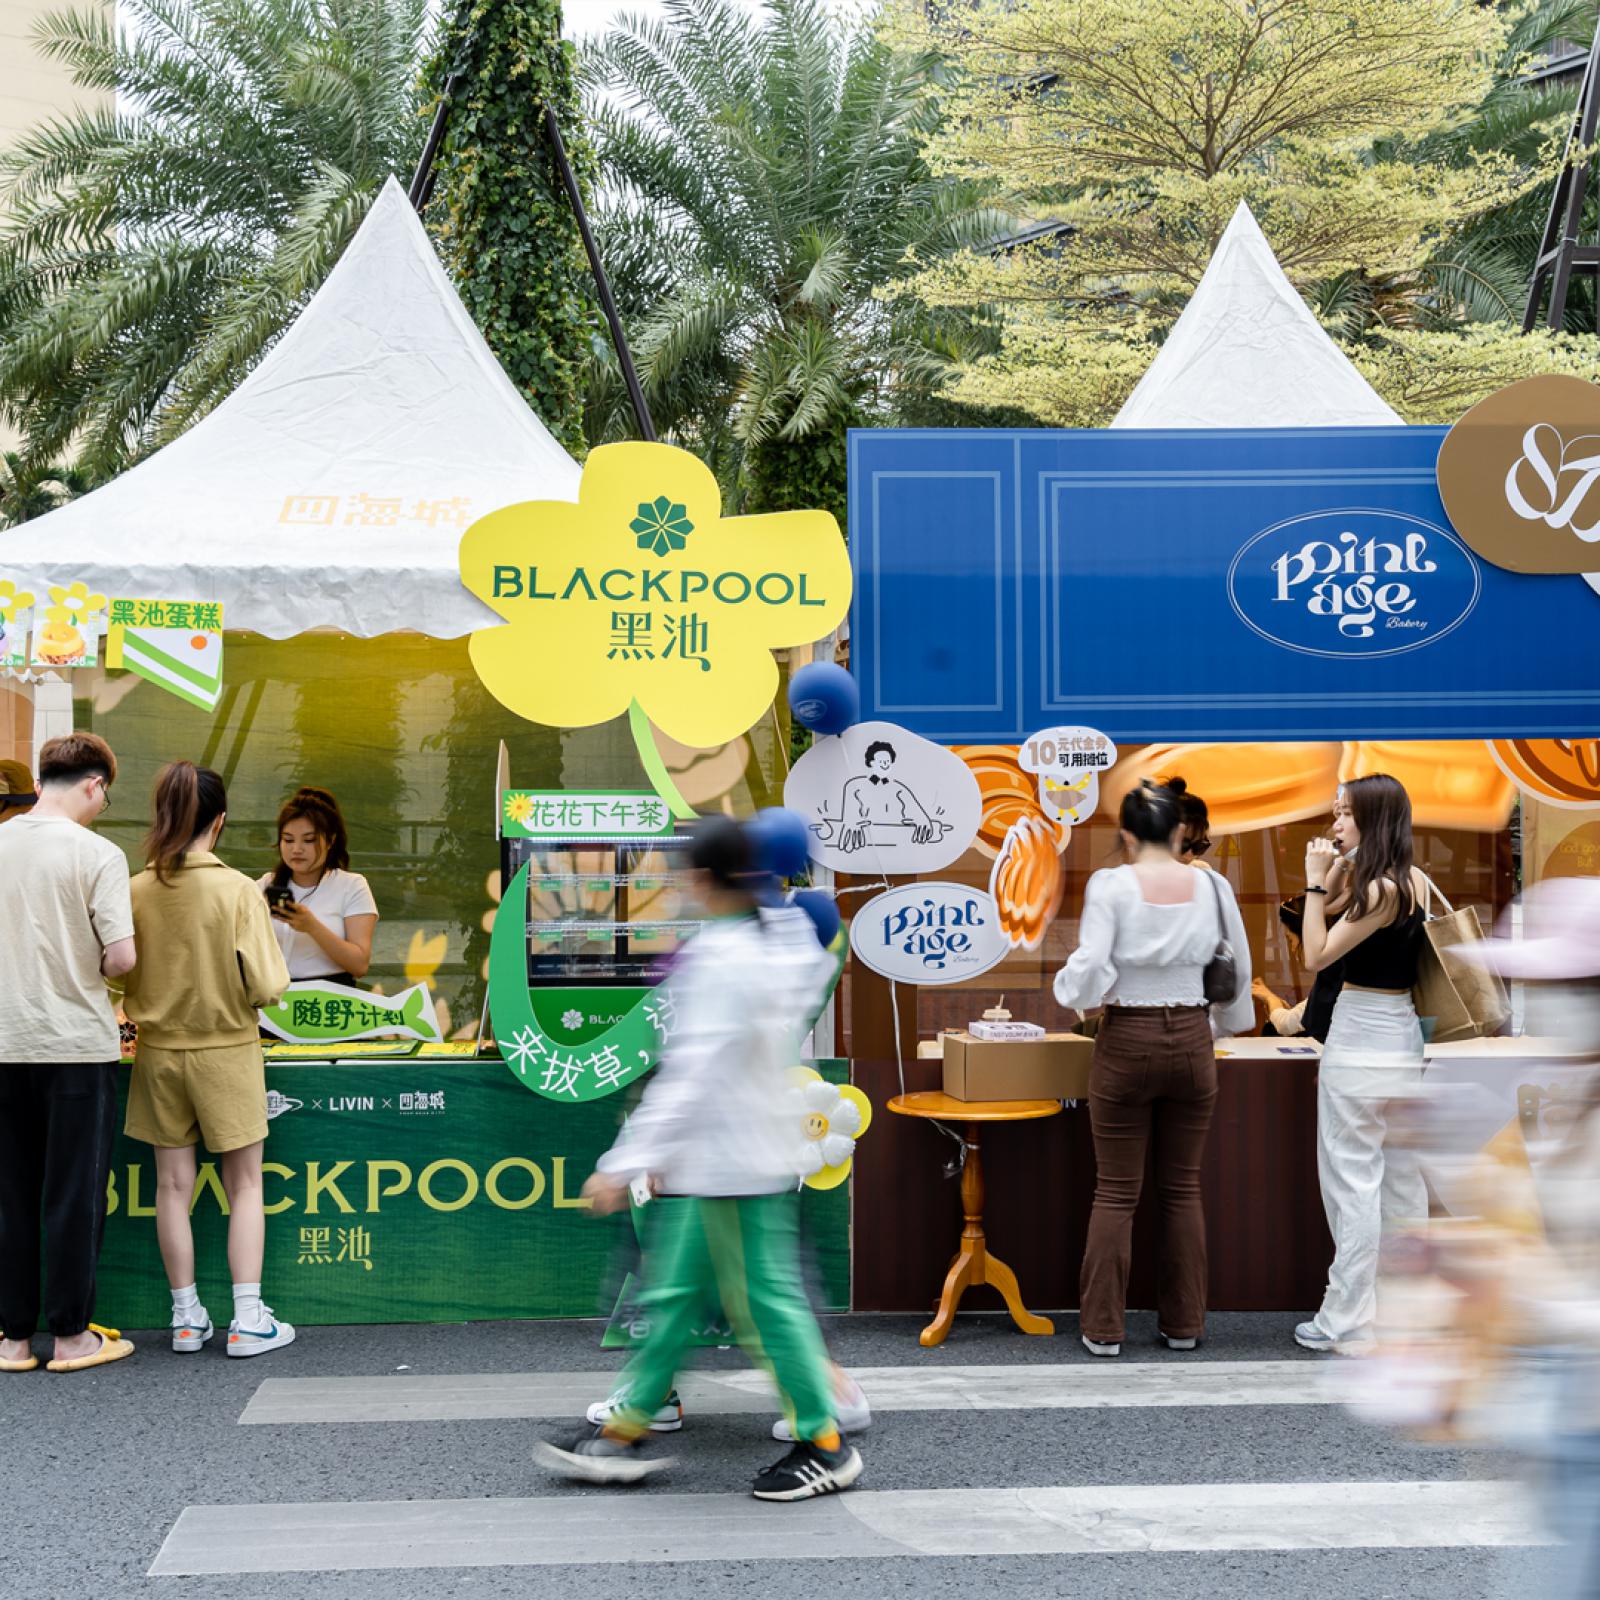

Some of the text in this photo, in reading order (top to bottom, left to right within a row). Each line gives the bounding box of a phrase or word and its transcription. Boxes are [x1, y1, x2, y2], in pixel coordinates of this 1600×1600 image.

[492, 565, 826, 607] BLACKPOOL
[111, 600, 221, 630] 黑池蛋糕
[1385, 616, 1429, 631] Bakery
[606, 611, 712, 672] 黑池
[1027, 740, 1057, 766] 10
[530, 800, 664, 828] 花花下午茶
[293, 997, 405, 1031] 随野计划
[329, 1097, 374, 1111] LIVIN
[106, 1156, 594, 1217] LACKPOOL
[296, 1226, 373, 1270] 黑池
